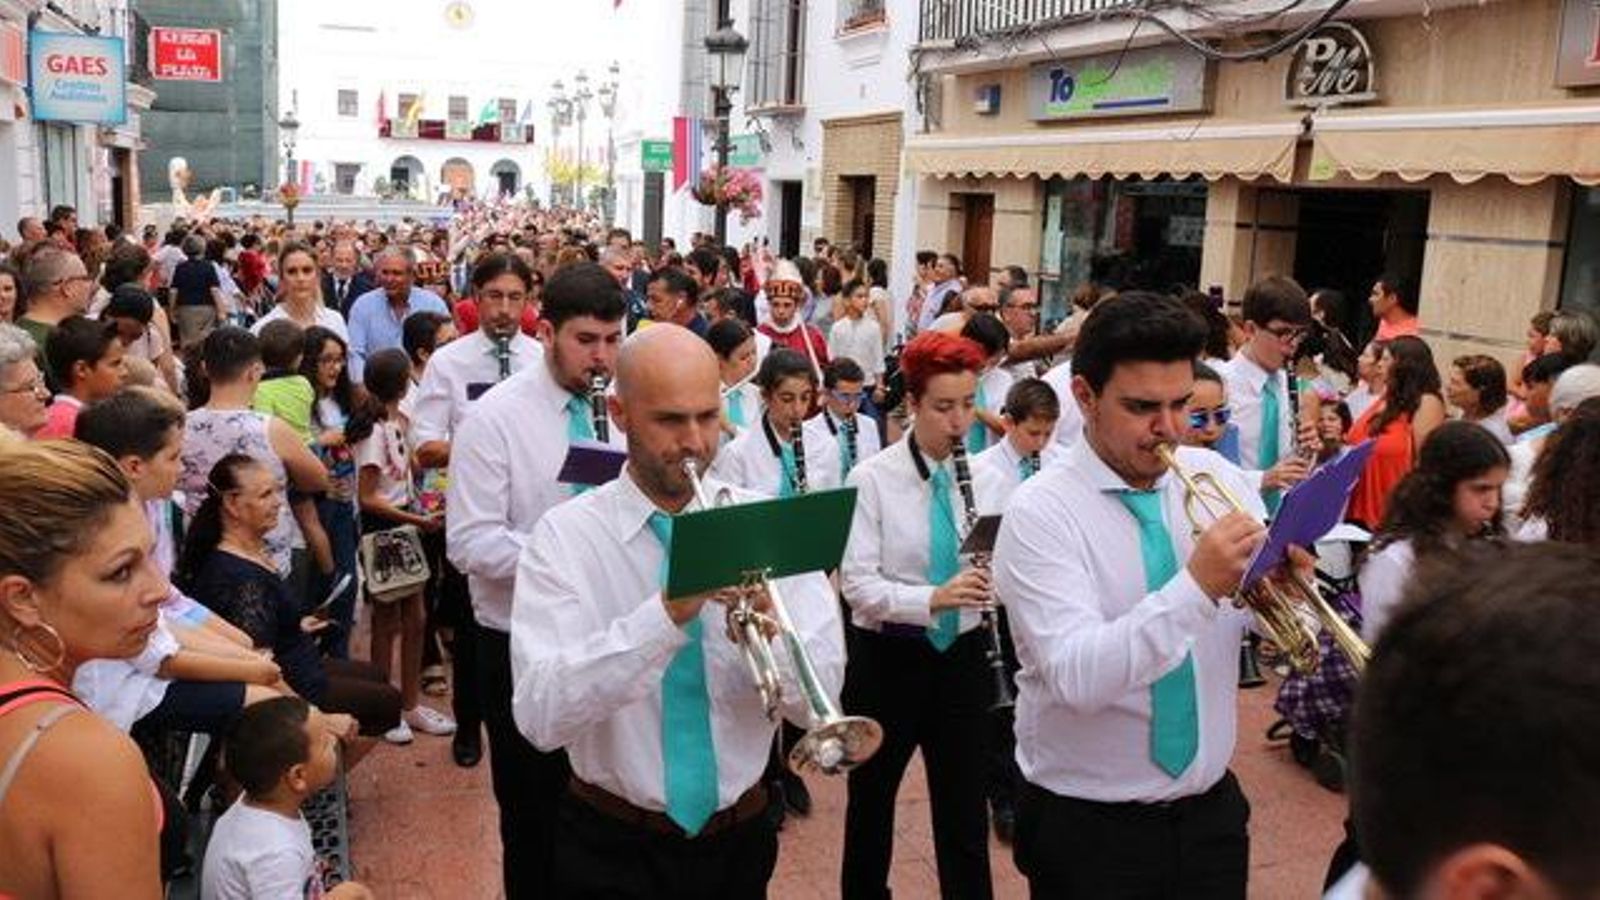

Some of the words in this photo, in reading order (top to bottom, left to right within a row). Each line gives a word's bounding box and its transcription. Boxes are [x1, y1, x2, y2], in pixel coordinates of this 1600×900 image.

[176, 47, 197, 60] LA
[47, 54, 108, 76] GAES
[1049, 68, 1075, 102] To
